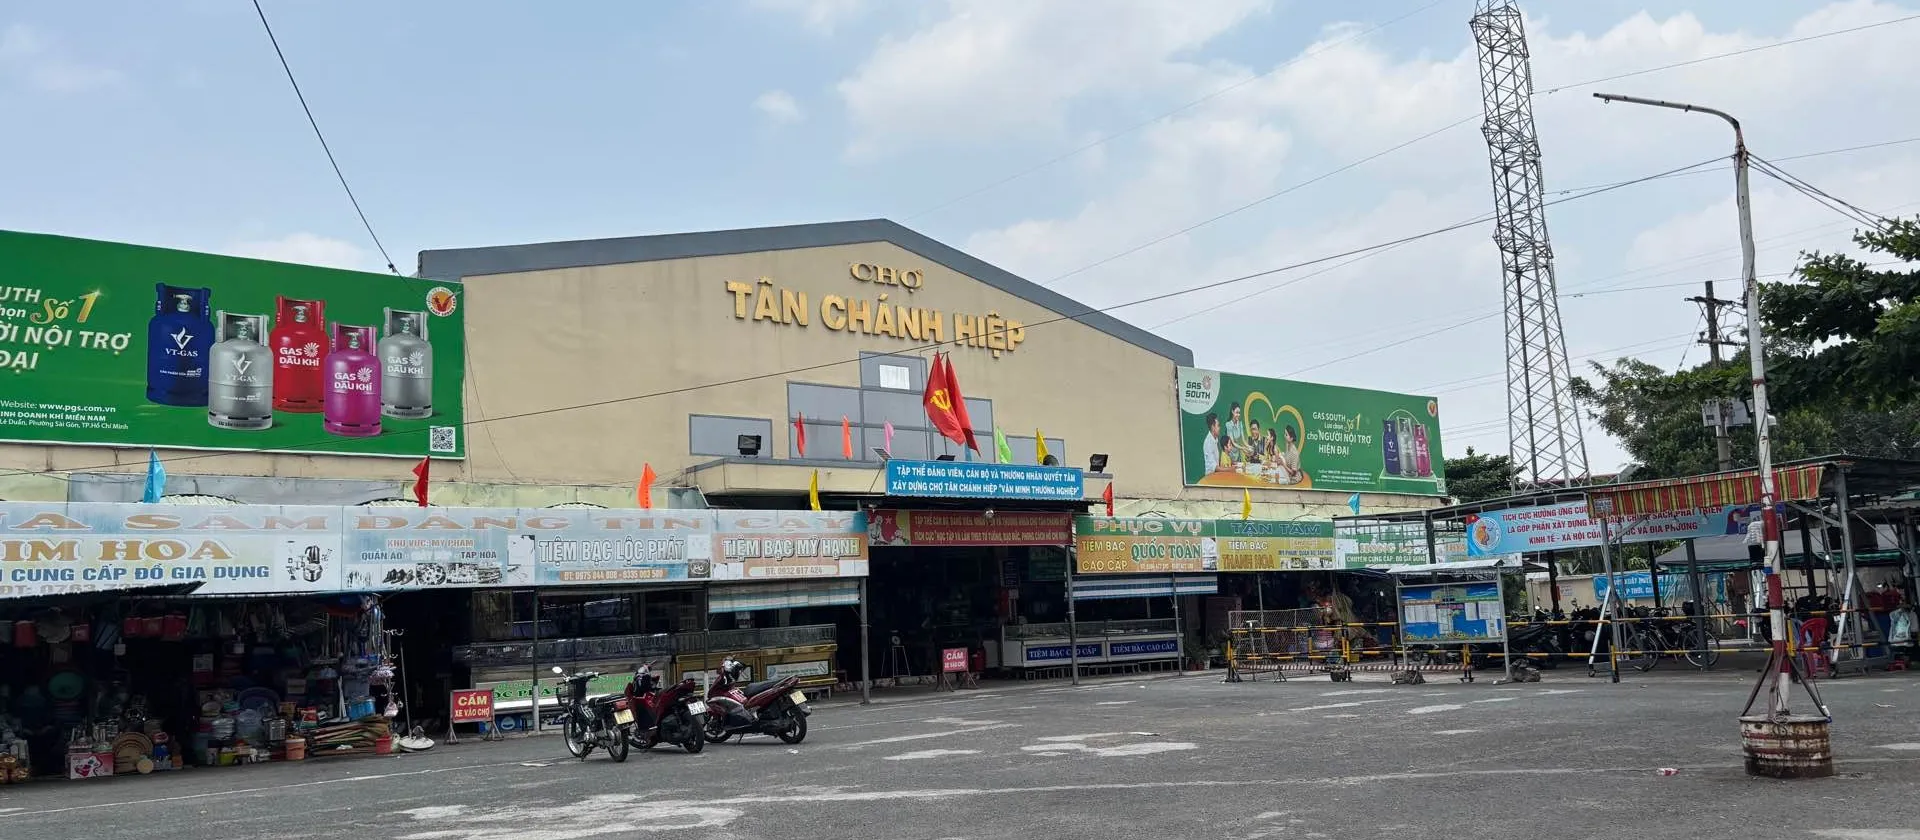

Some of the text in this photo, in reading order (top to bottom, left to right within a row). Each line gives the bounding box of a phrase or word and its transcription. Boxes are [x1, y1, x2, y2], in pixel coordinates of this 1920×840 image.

[850, 262, 925, 293] CHỢ
[30, 298, 75, 325] Số
[77, 287, 103, 323] 1
[726, 276, 1026, 358] TÂN CHÁNH HIỆP
[24, 324, 131, 355] NỘI TRỢ
[165, 348, 199, 357] VT-GAS
[279, 346, 303, 356] GAS
[302, 356, 320, 367] KHÍ
[387, 355, 409, 365] GAS
[334, 371, 357, 381] GAS
[356, 381, 373, 392] KHÍ
[1186, 381, 1202, 390] GAS
[1185, 390, 1211, 400] SOUTH
[0, 400, 116, 413] Website: www.pgs.com.vn
[1312, 411, 1346, 422] GAS SOUTH
[1318, 443, 1336, 457] HIỆN
[896, 465, 911, 477] TẬP
[926, 466, 946, 477] ĐẢNG
[947, 467, 965, 479] VIÊN,
[965, 466, 979, 478] CÁN
[980, 467, 990, 480] BỘ
[991, 467, 999, 479] VÀ
[1000, 470, 1025, 480] THƯƠNG
[1026, 470, 1043, 481] NHÂN
[1043, 469, 1063, 483] QUYẾT
[1063, 470, 1076, 482] TÂM
[892, 480, 907, 491] XÂY
[908, 481, 928, 493] DỰNG
[928, 482, 944, 493] CHỢ
[944, 481, 958, 492] TÂN
[958, 482, 982, 493] CHÁNH
[982, 483, 998, 496] HIỆP
[1015, 485, 1031, 494] MINH
[1031, 485, 1056, 495] THƯƠNG
[594, 517, 705, 531] TIN
[1093, 519, 1202, 536] PHỤC VỤ
[1230, 521, 1273, 537] TẬN
[1279, 522, 1322, 535] TÂM
[1529, 535, 1546, 545] KINH
[99, 540, 233, 561] HOA
[539, 535, 684, 567] TIỆM BẠC LỘC PHÁT
[722, 534, 860, 562] TIỆM BẠC MỸ HẠNH
[1131, 536, 1201, 564] QUỐC TOÀN
[1082, 560, 1105, 571] CAO
[1107, 555, 1128, 571] CẤP
[11, 568, 75, 582] CUNG
[172, 566, 206, 580] GIA
[214, 565, 270, 581] DỤNG
[458, 692, 488, 707] CẤM
[455, 706, 491, 718] XE VÀO CHỢ
